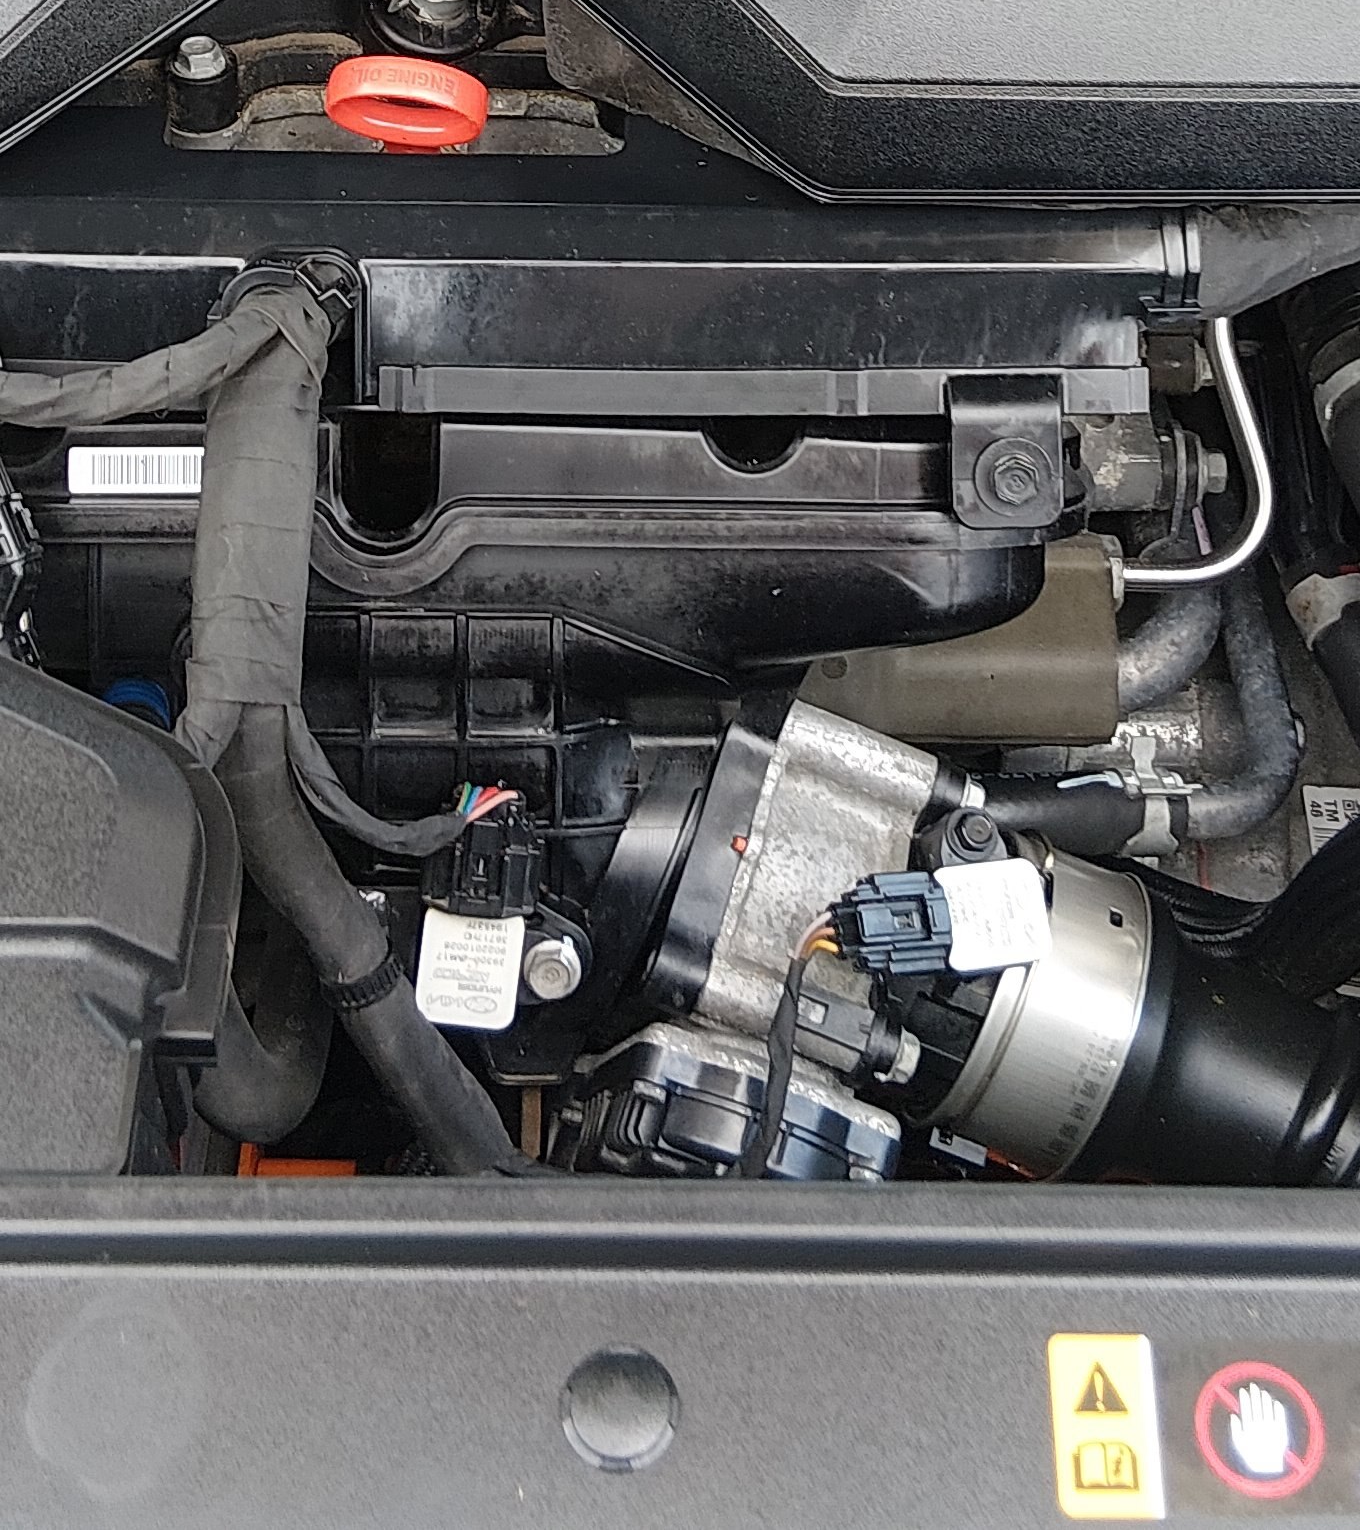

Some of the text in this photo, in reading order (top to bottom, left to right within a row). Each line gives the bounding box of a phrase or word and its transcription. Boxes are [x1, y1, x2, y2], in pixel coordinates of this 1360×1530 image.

[354, 67, 457, 94] ENGINE OIL
[1324, 799, 1340, 822] TM
